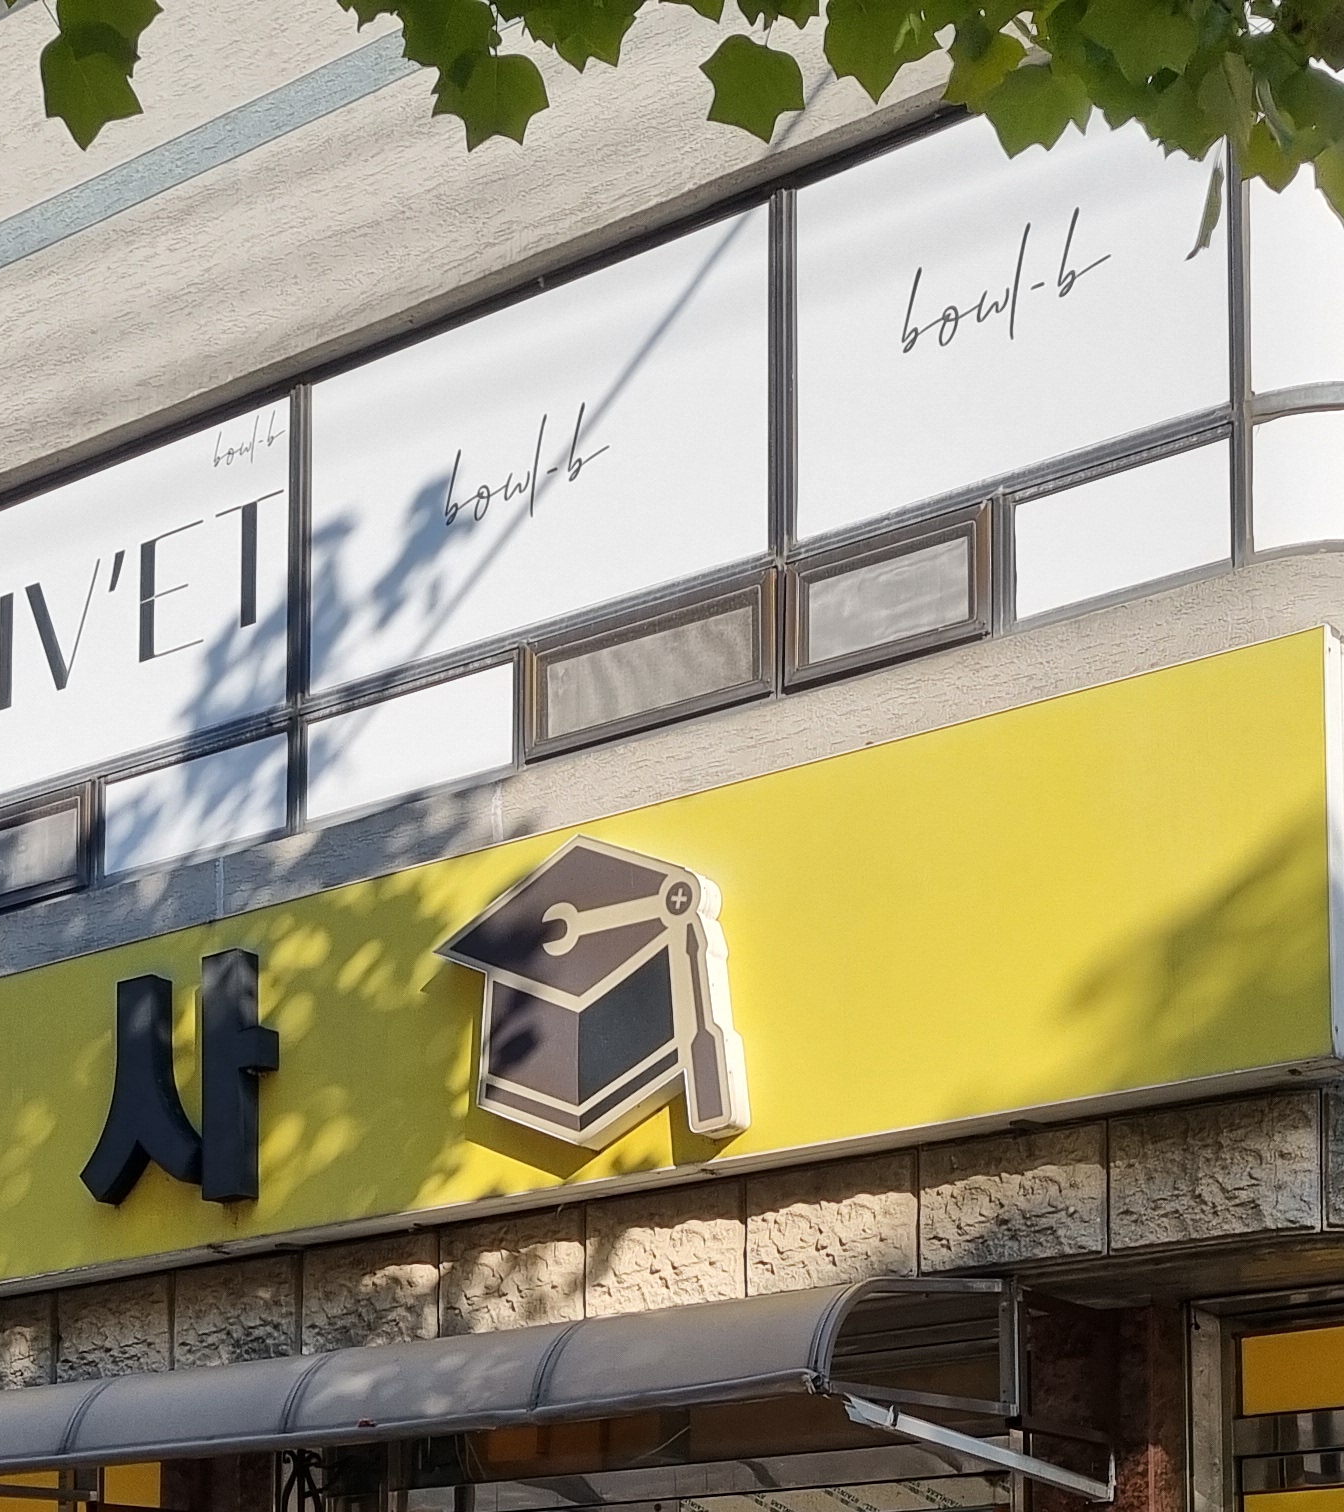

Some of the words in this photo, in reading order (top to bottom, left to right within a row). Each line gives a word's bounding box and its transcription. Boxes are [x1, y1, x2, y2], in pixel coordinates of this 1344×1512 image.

[902, 207, 1112, 353] bowl-b
[213, 410, 286, 468] bowl-b
[444, 402, 610, 526] bowl-b
